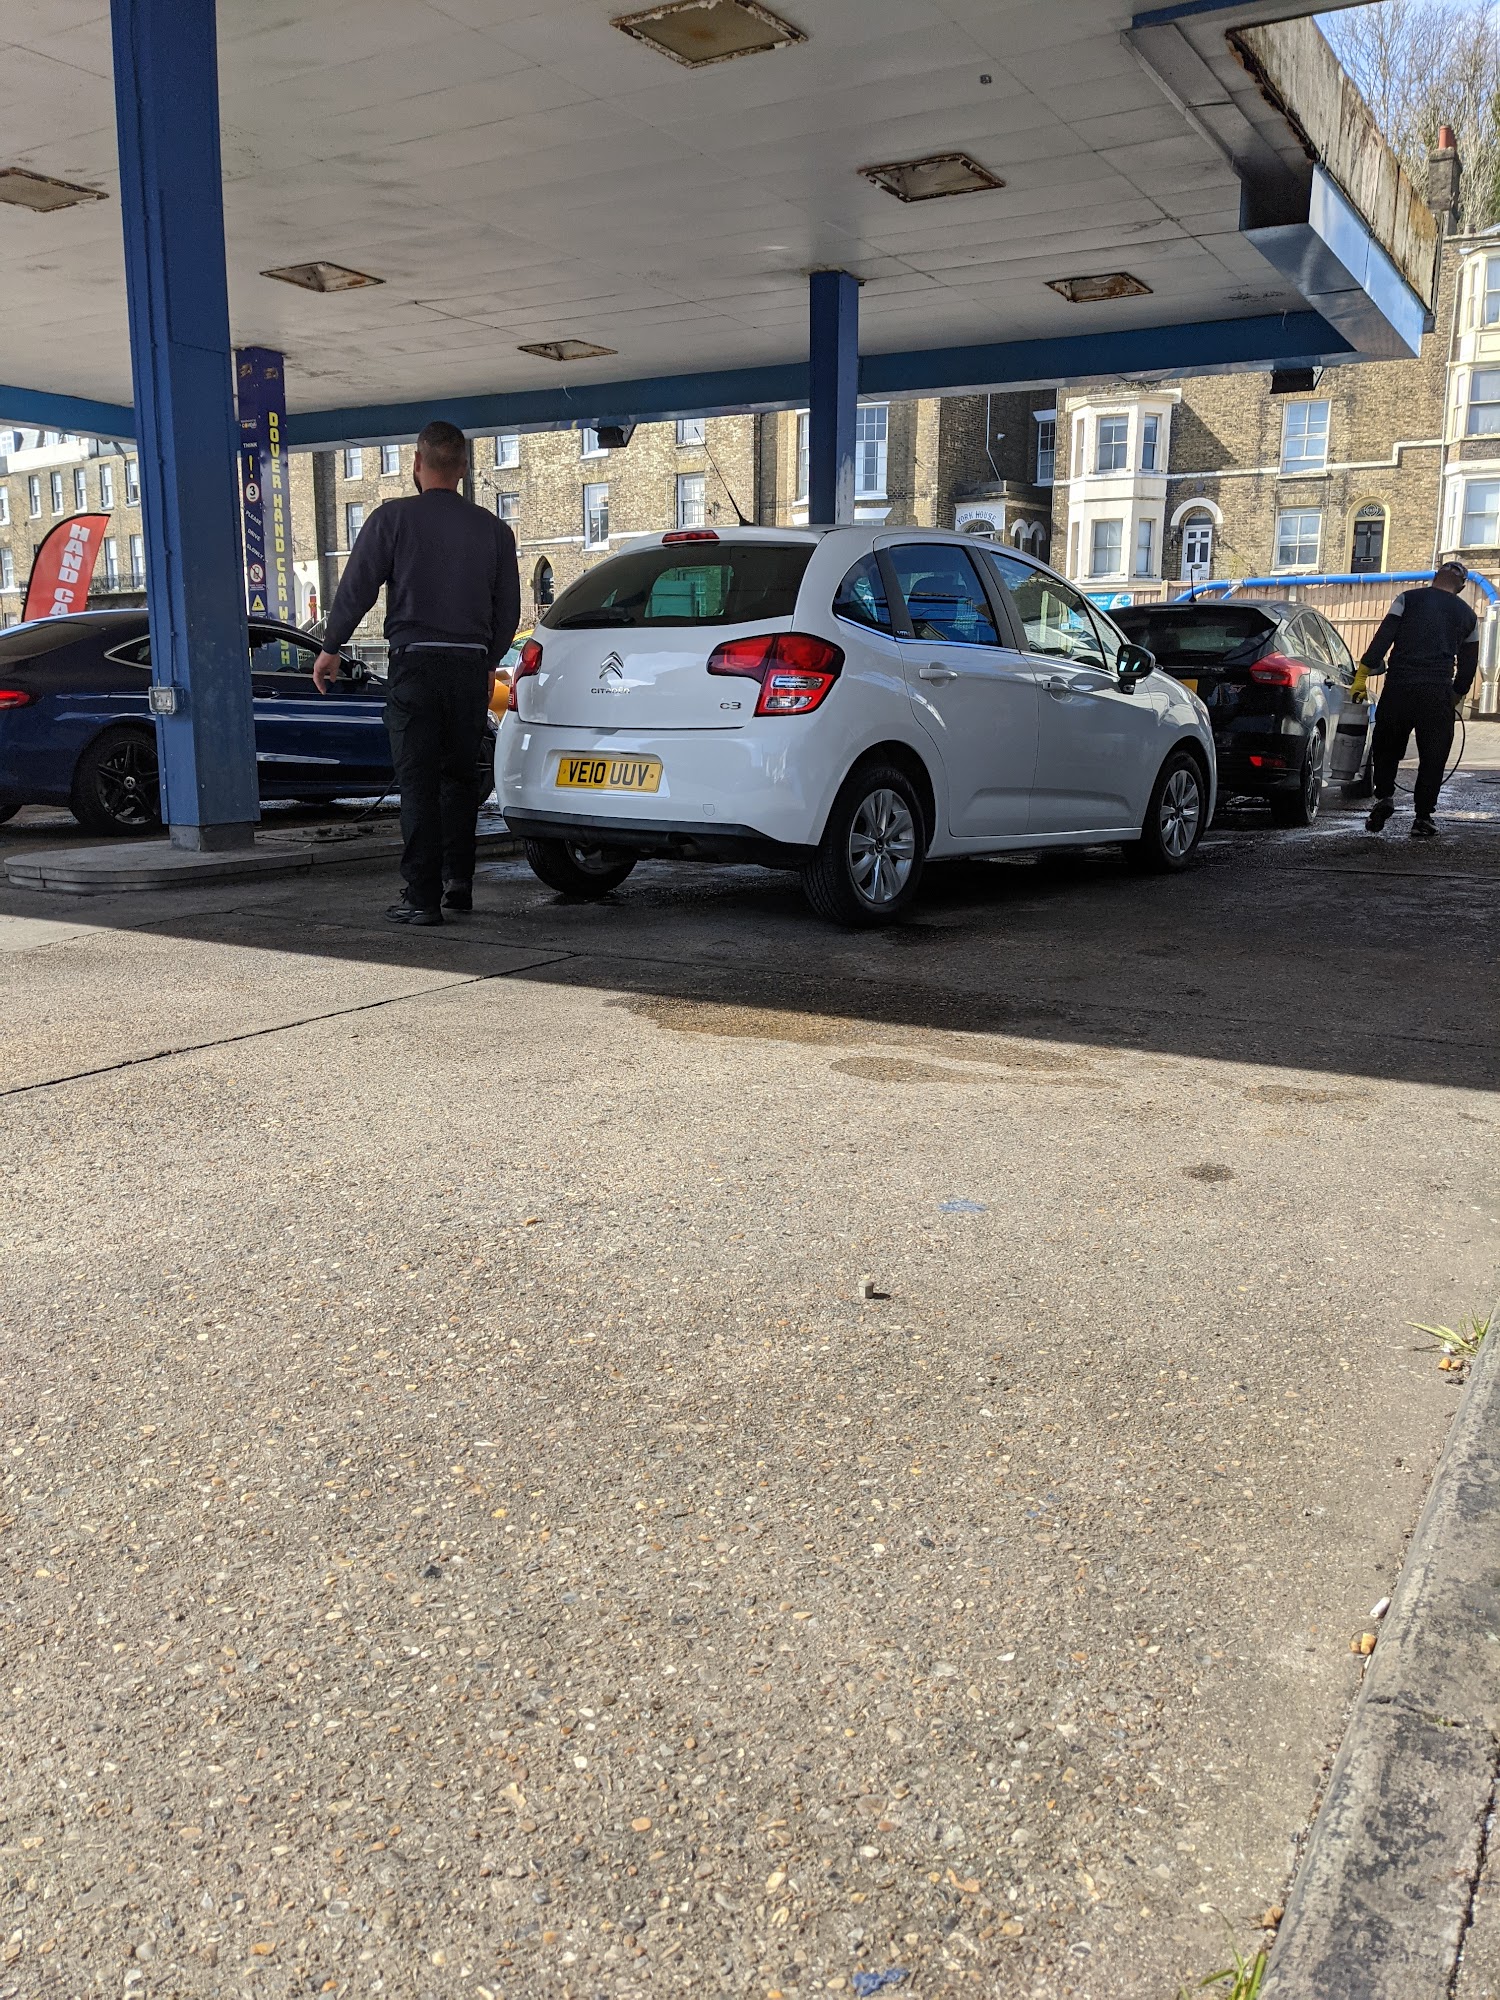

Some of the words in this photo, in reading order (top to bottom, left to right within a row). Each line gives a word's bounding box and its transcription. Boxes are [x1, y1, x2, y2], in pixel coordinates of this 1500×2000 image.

[268, 411, 282, 489] DOVER
[249, 485, 256, 497] 3
[245, 510, 262, 526] PLEASE
[273, 493, 285, 553] HAND
[956, 511, 974, 525] YORK
[975, 510, 997, 524] HOUSE
[247, 528, 261, 542] DRIVE
[58, 523, 91, 584] HAND
[276, 557, 288, 602] CAR
[719, 701, 742, 710] C3
[569, 760, 607, 784] VE10
[609, 762, 650, 787] UUV
